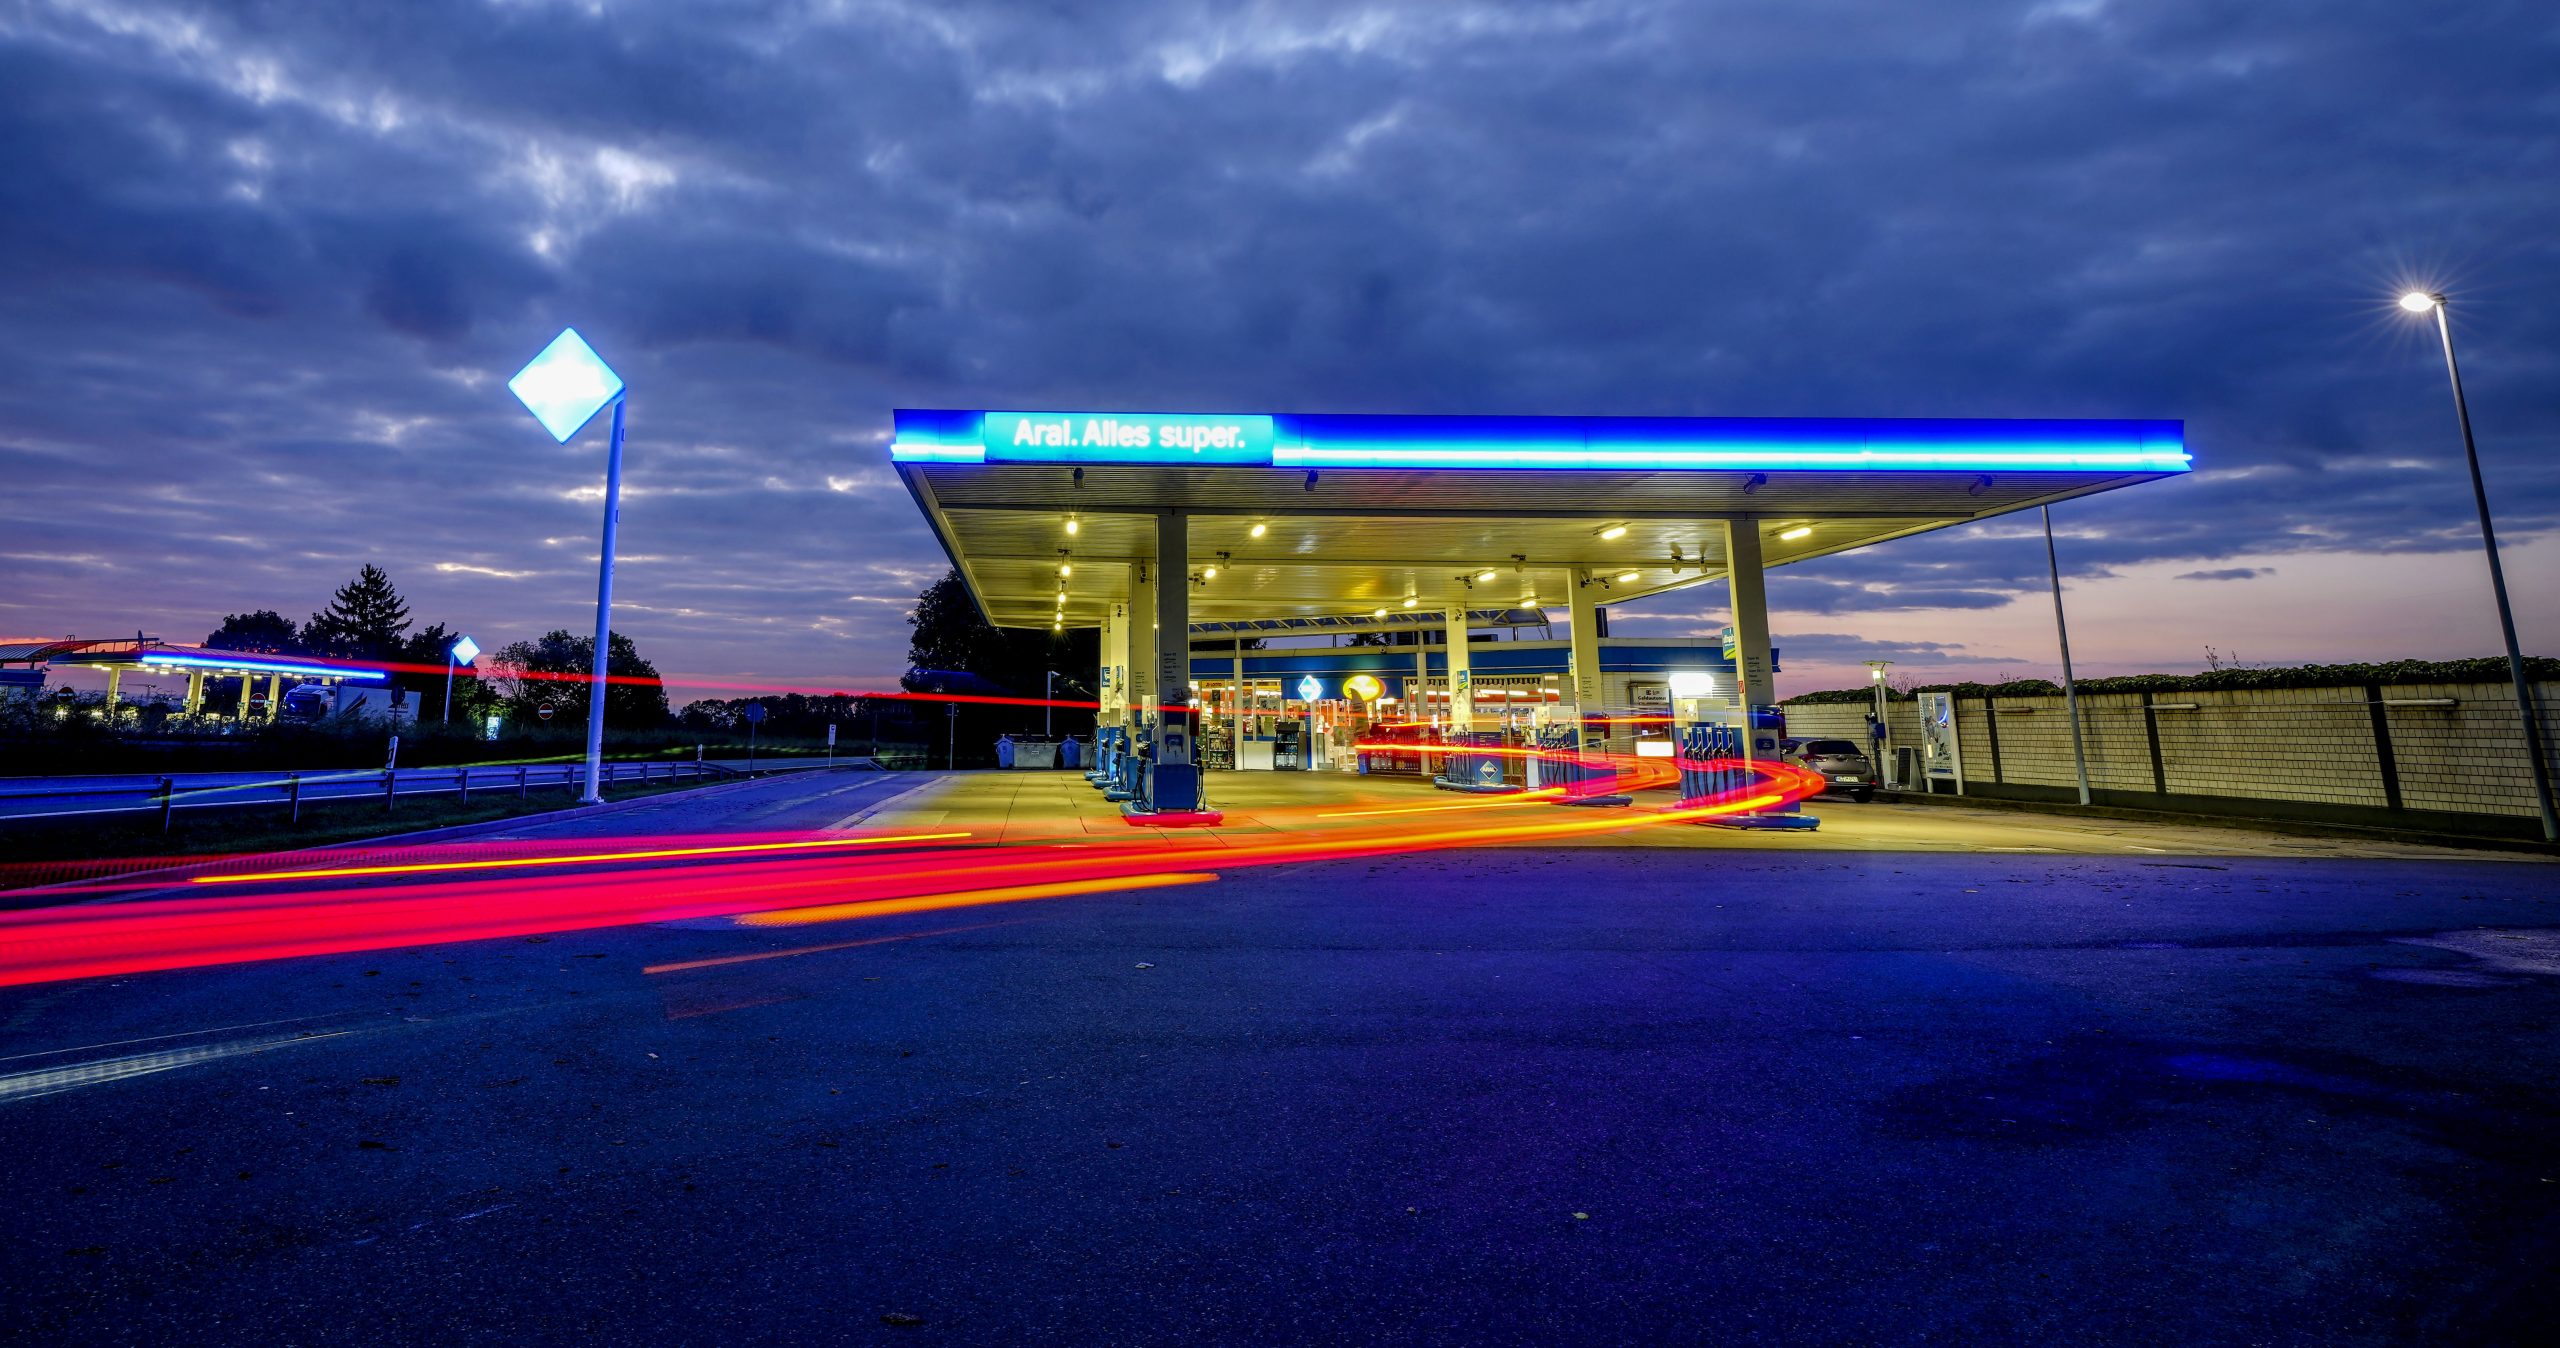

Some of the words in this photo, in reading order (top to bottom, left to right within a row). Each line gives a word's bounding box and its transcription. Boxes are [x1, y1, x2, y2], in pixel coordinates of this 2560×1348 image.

[1013, 418, 1078, 447] Aral.
[1081, 419, 1151, 448] Alles
[1159, 424, 1246, 454] super.
